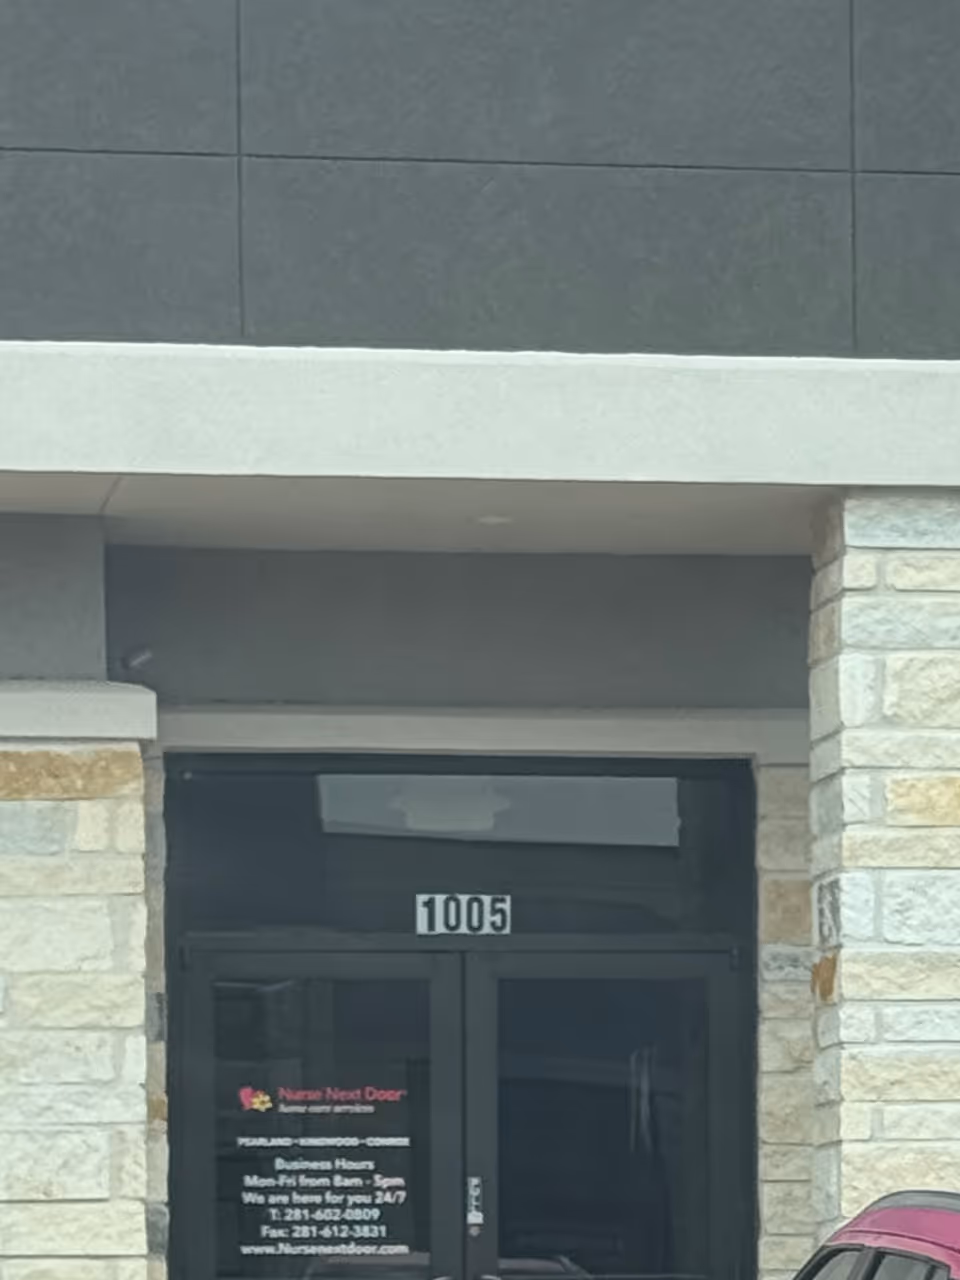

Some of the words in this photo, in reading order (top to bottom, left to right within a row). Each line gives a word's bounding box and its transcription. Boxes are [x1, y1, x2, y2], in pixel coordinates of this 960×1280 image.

[421, 896, 508, 934] 1005
[278, 1087, 322, 1101] Nurse
[365, 1086, 401, 1101] Door
[275, 1157, 332, 1171] Business
[335, 1158, 375, 1171] Hours
[243, 1175, 297, 1187] Mon-Fri
[299, 1175, 331, 1187] from
[242, 1192, 265, 1204] We
[268, 1195, 289, 1204] are
[292, 1192, 322, 1204] here
[325, 1191, 345, 1204] for
[347, 1195, 372, 1207] you
[374, 1191, 406, 1205] 24/7
